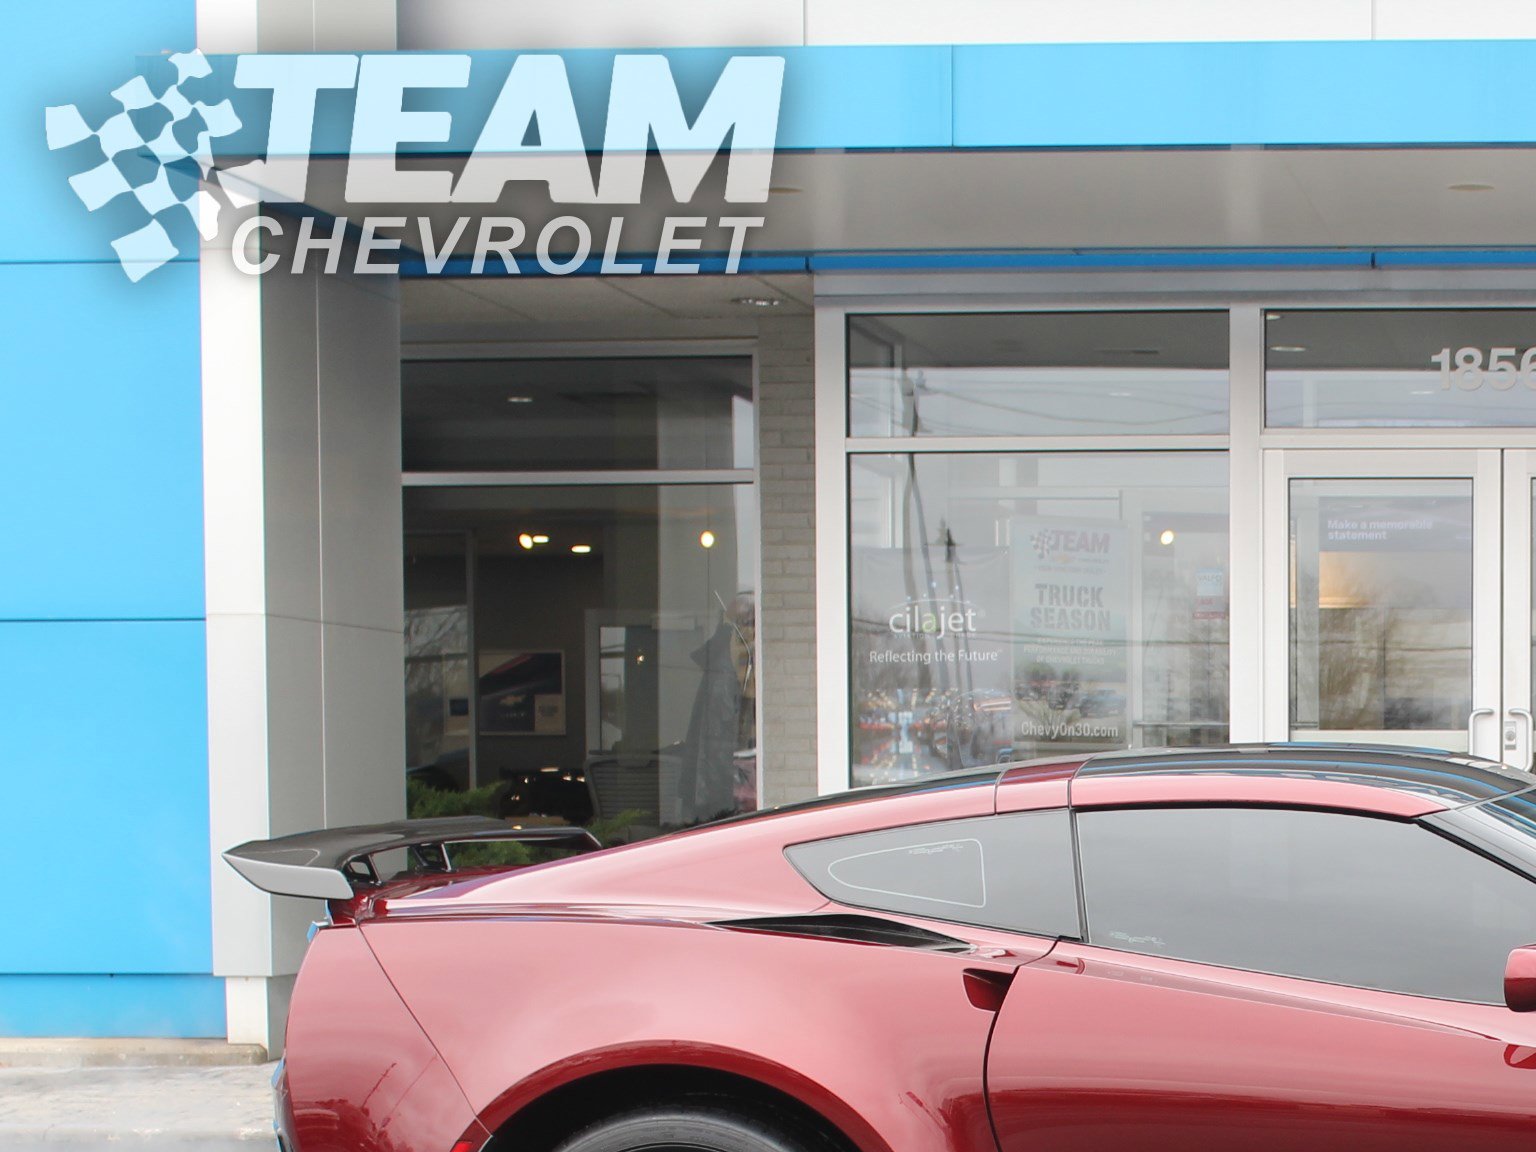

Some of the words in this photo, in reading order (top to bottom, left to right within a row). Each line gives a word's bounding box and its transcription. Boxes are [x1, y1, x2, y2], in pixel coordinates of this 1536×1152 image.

[1050, 529, 1110, 553] TEAM
[1034, 583, 1104, 608] TRUCK
[889, 605, 977, 639] cilajet
[1030, 606, 1111, 631] SEASON
[869, 650, 931, 665] Reflecting
[934, 650, 955, 662] the
[1021, 721, 1119, 739] ChevyOn30.com
